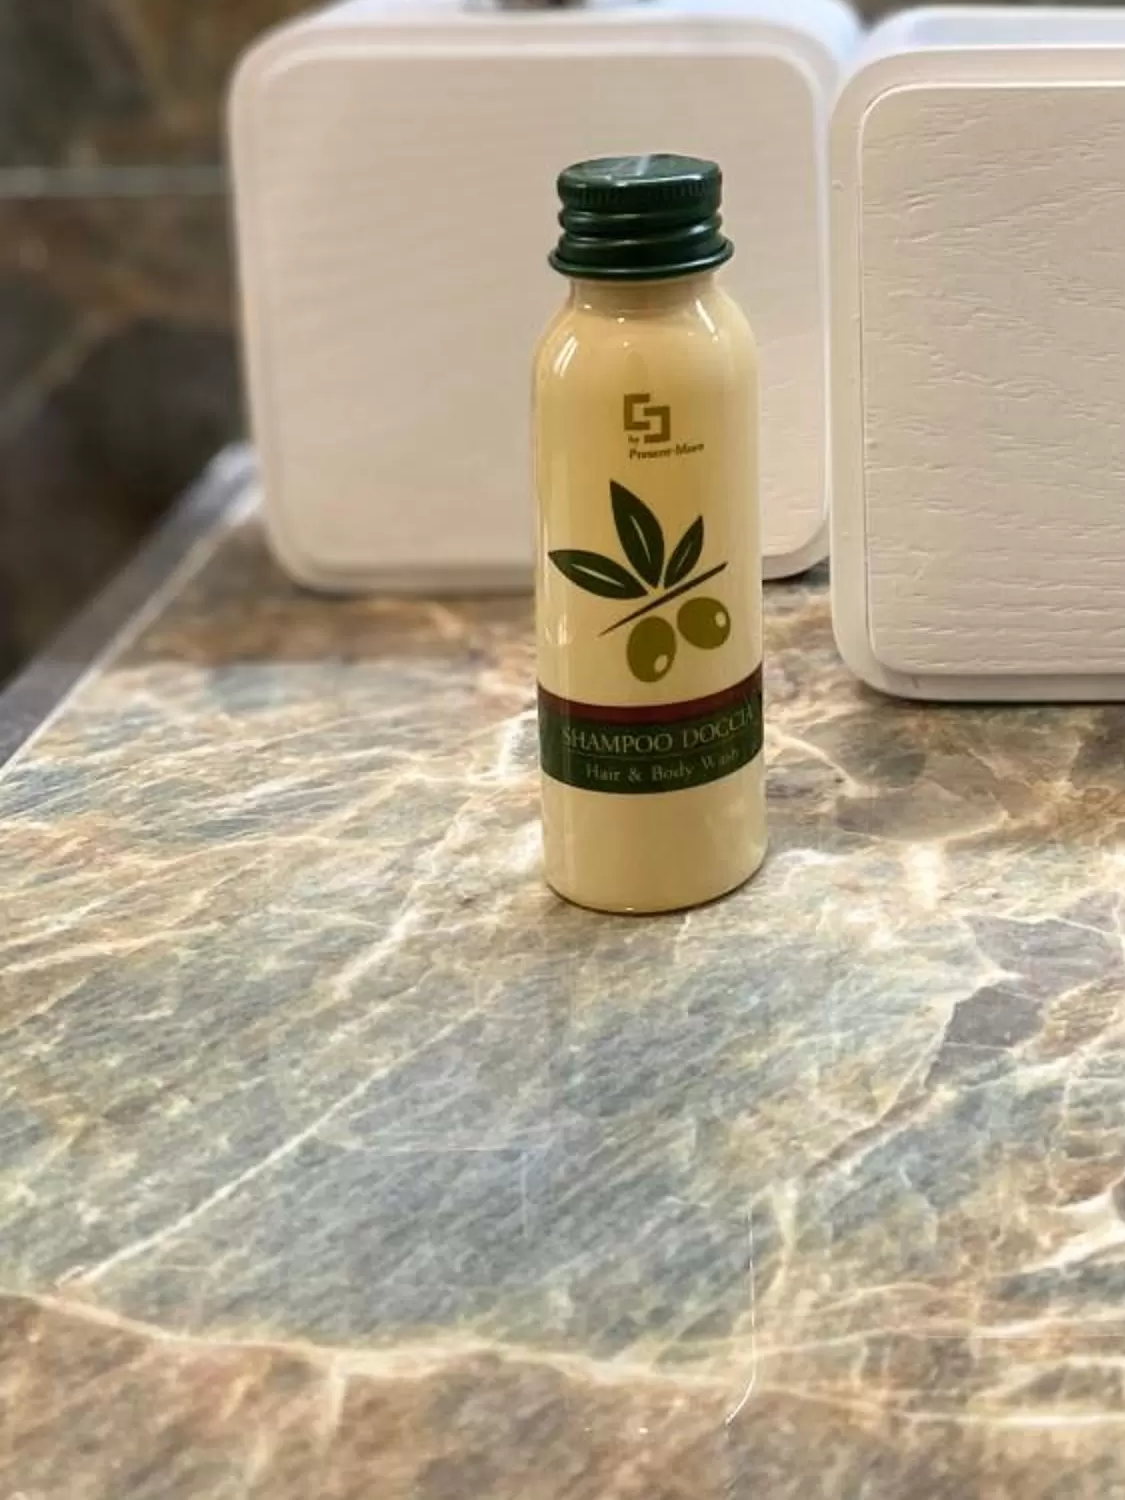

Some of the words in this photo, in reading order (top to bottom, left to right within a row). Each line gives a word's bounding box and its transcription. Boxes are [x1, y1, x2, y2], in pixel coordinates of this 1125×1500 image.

[561, 726, 674, 754] SHAMPOO
[682, 702, 754, 749] DOCCIA
[585, 762, 621, 782] Hair
[627, 767, 643, 784] &
[651, 758, 695, 782] Body
